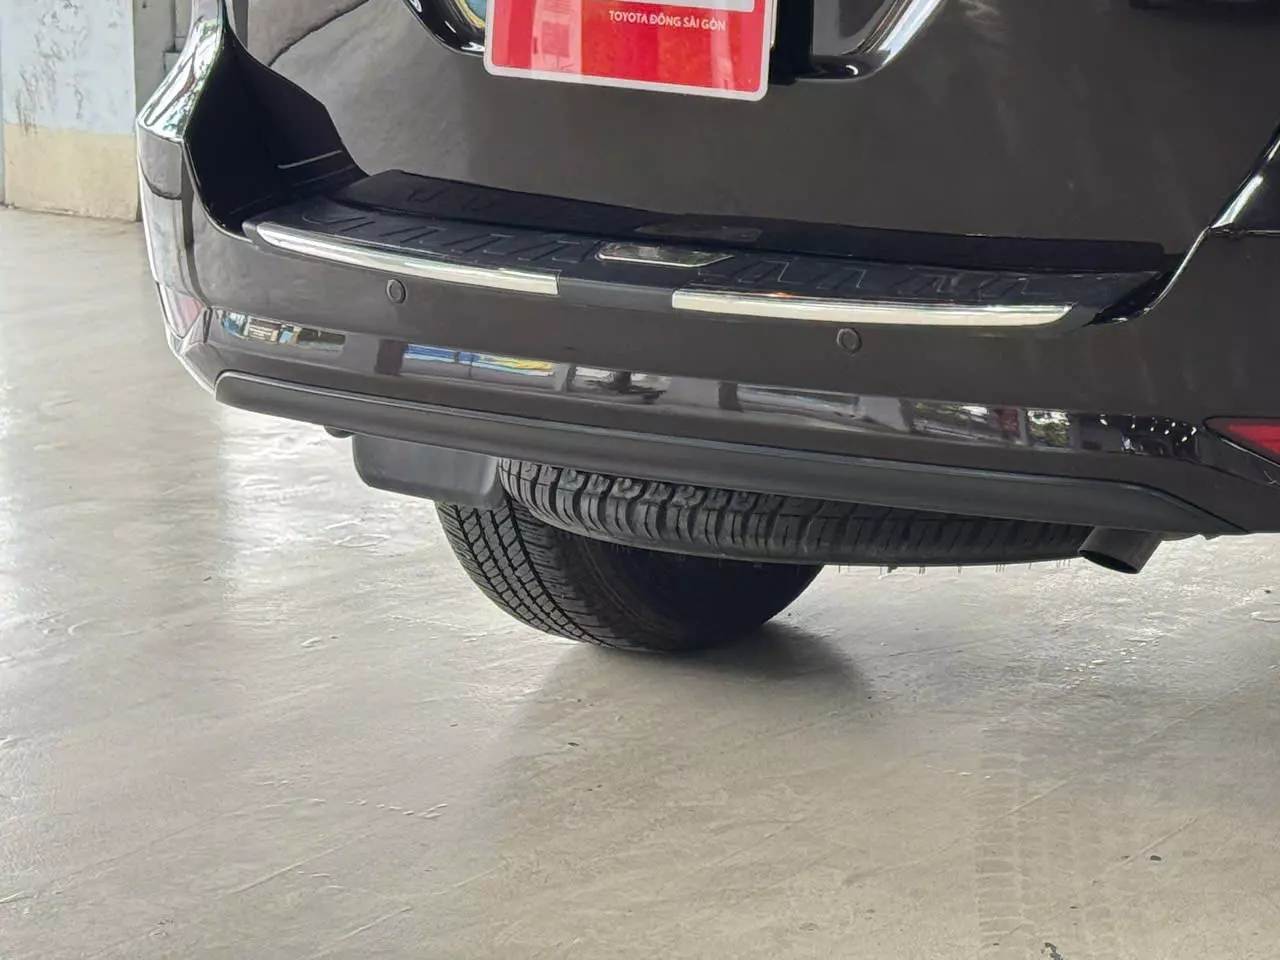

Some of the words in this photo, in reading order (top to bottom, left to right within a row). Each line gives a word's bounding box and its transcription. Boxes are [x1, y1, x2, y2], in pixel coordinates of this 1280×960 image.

[608, 10, 649, 25] TOYOTA
[649, 12, 682, 27] ĐÔNG
[683, 15, 700, 29] SÀI
